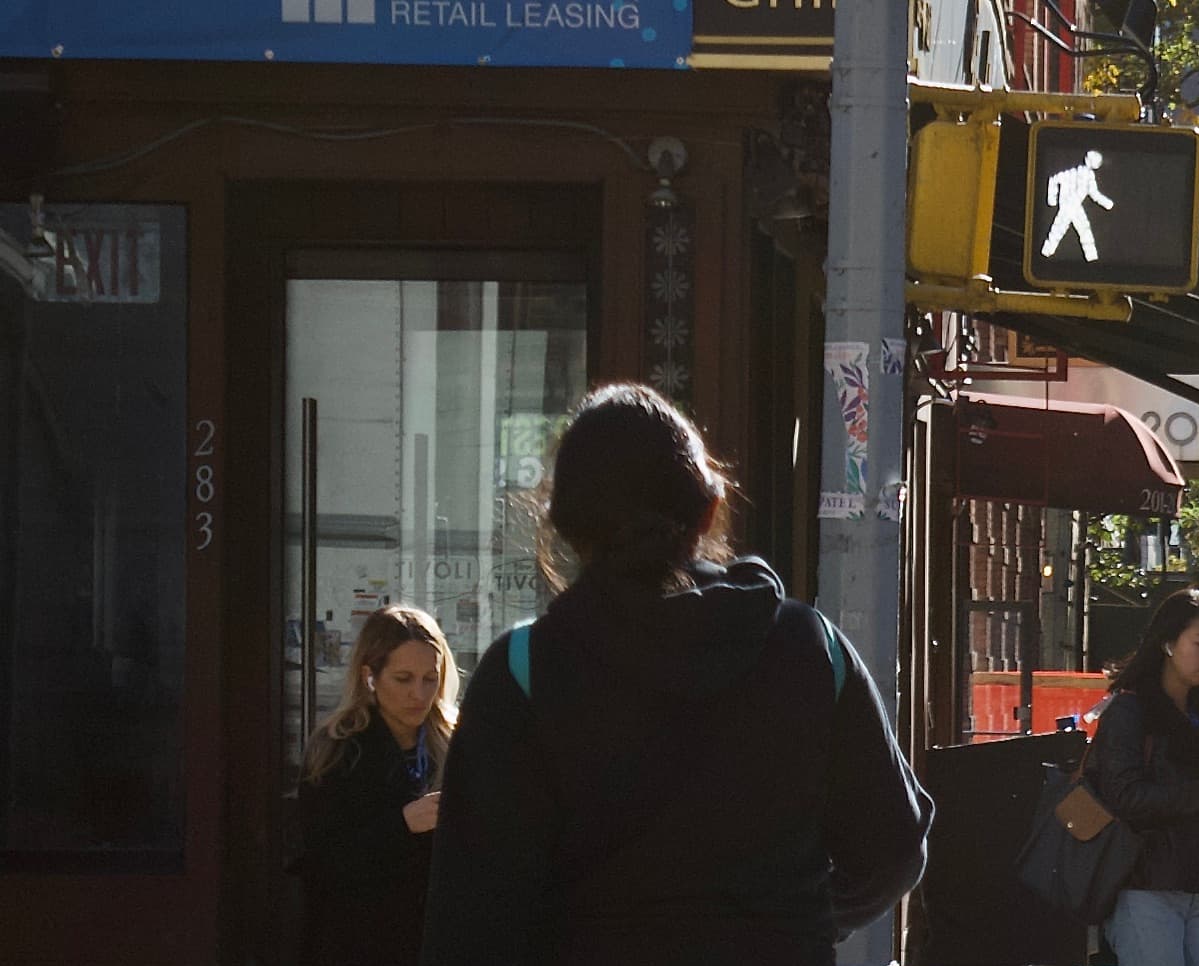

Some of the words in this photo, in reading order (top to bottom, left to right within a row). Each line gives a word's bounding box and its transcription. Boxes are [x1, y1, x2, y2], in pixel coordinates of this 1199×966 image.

[390, 1, 497, 26] RETAIL
[506, 2, 640, 29] LEASING
[194, 420, 215, 550] 283
